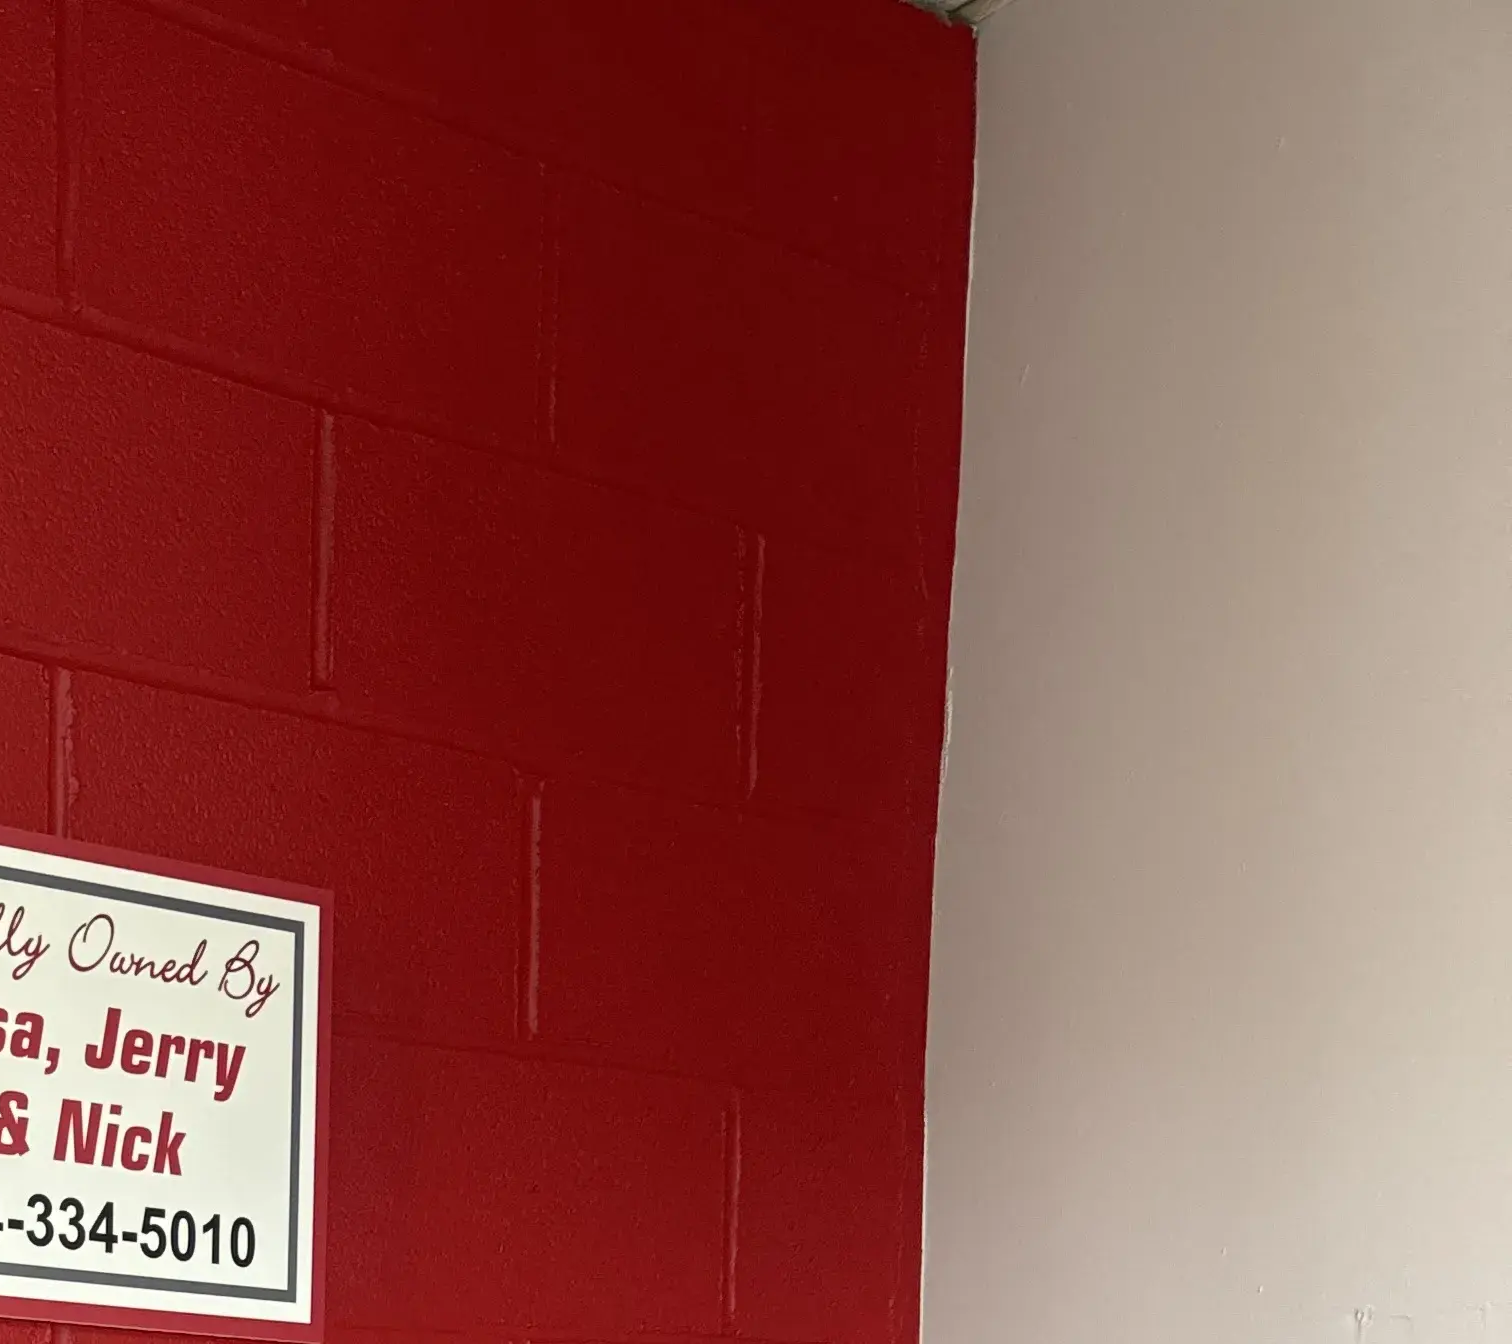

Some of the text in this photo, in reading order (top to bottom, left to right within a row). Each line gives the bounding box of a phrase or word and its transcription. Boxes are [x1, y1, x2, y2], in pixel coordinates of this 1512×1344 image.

[68, 914, 208, 985] Owned
[218, 940, 279, 1017] By
[85, 1007, 246, 1101] Jerry
[54, 1098, 187, 1176] Nick
